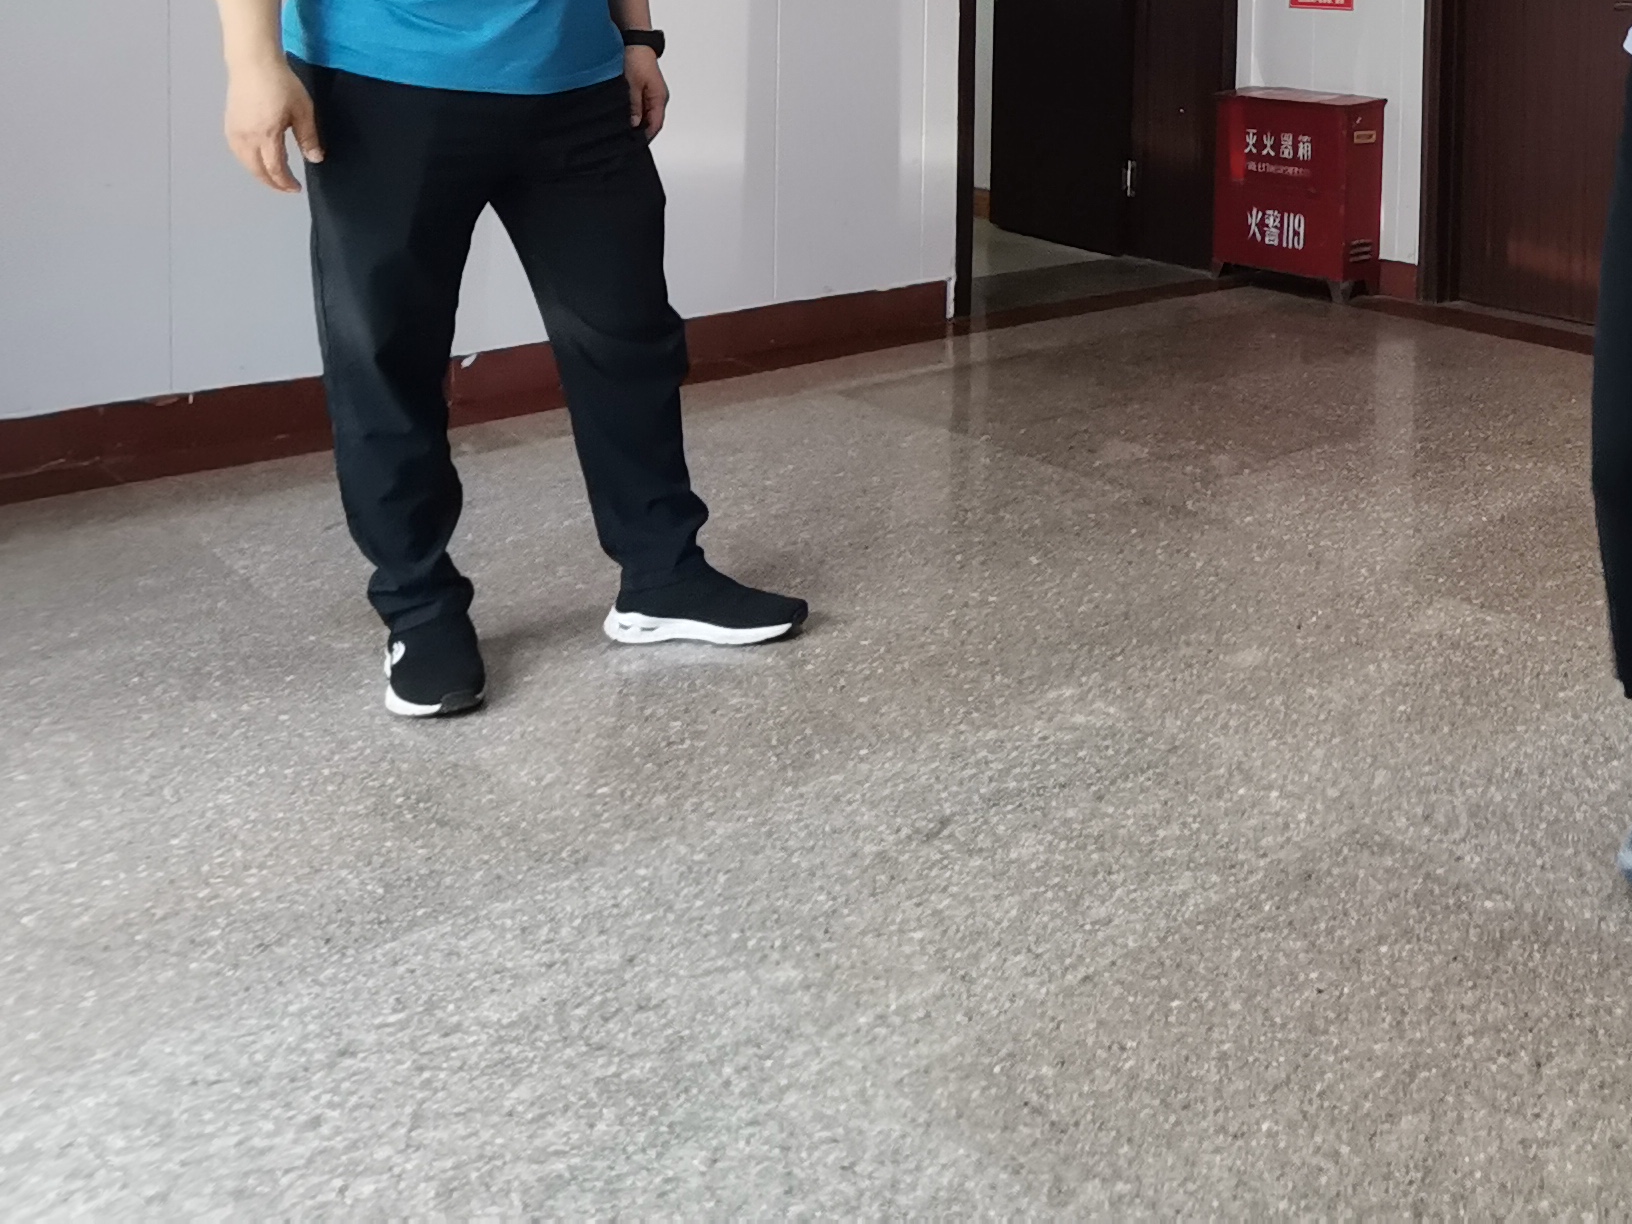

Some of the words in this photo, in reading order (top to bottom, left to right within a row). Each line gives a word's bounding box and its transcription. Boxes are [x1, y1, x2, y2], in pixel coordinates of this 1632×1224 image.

[1243, 128, 1312, 162] 灭火器箱
[1246, 206, 1305, 251] 火警119
